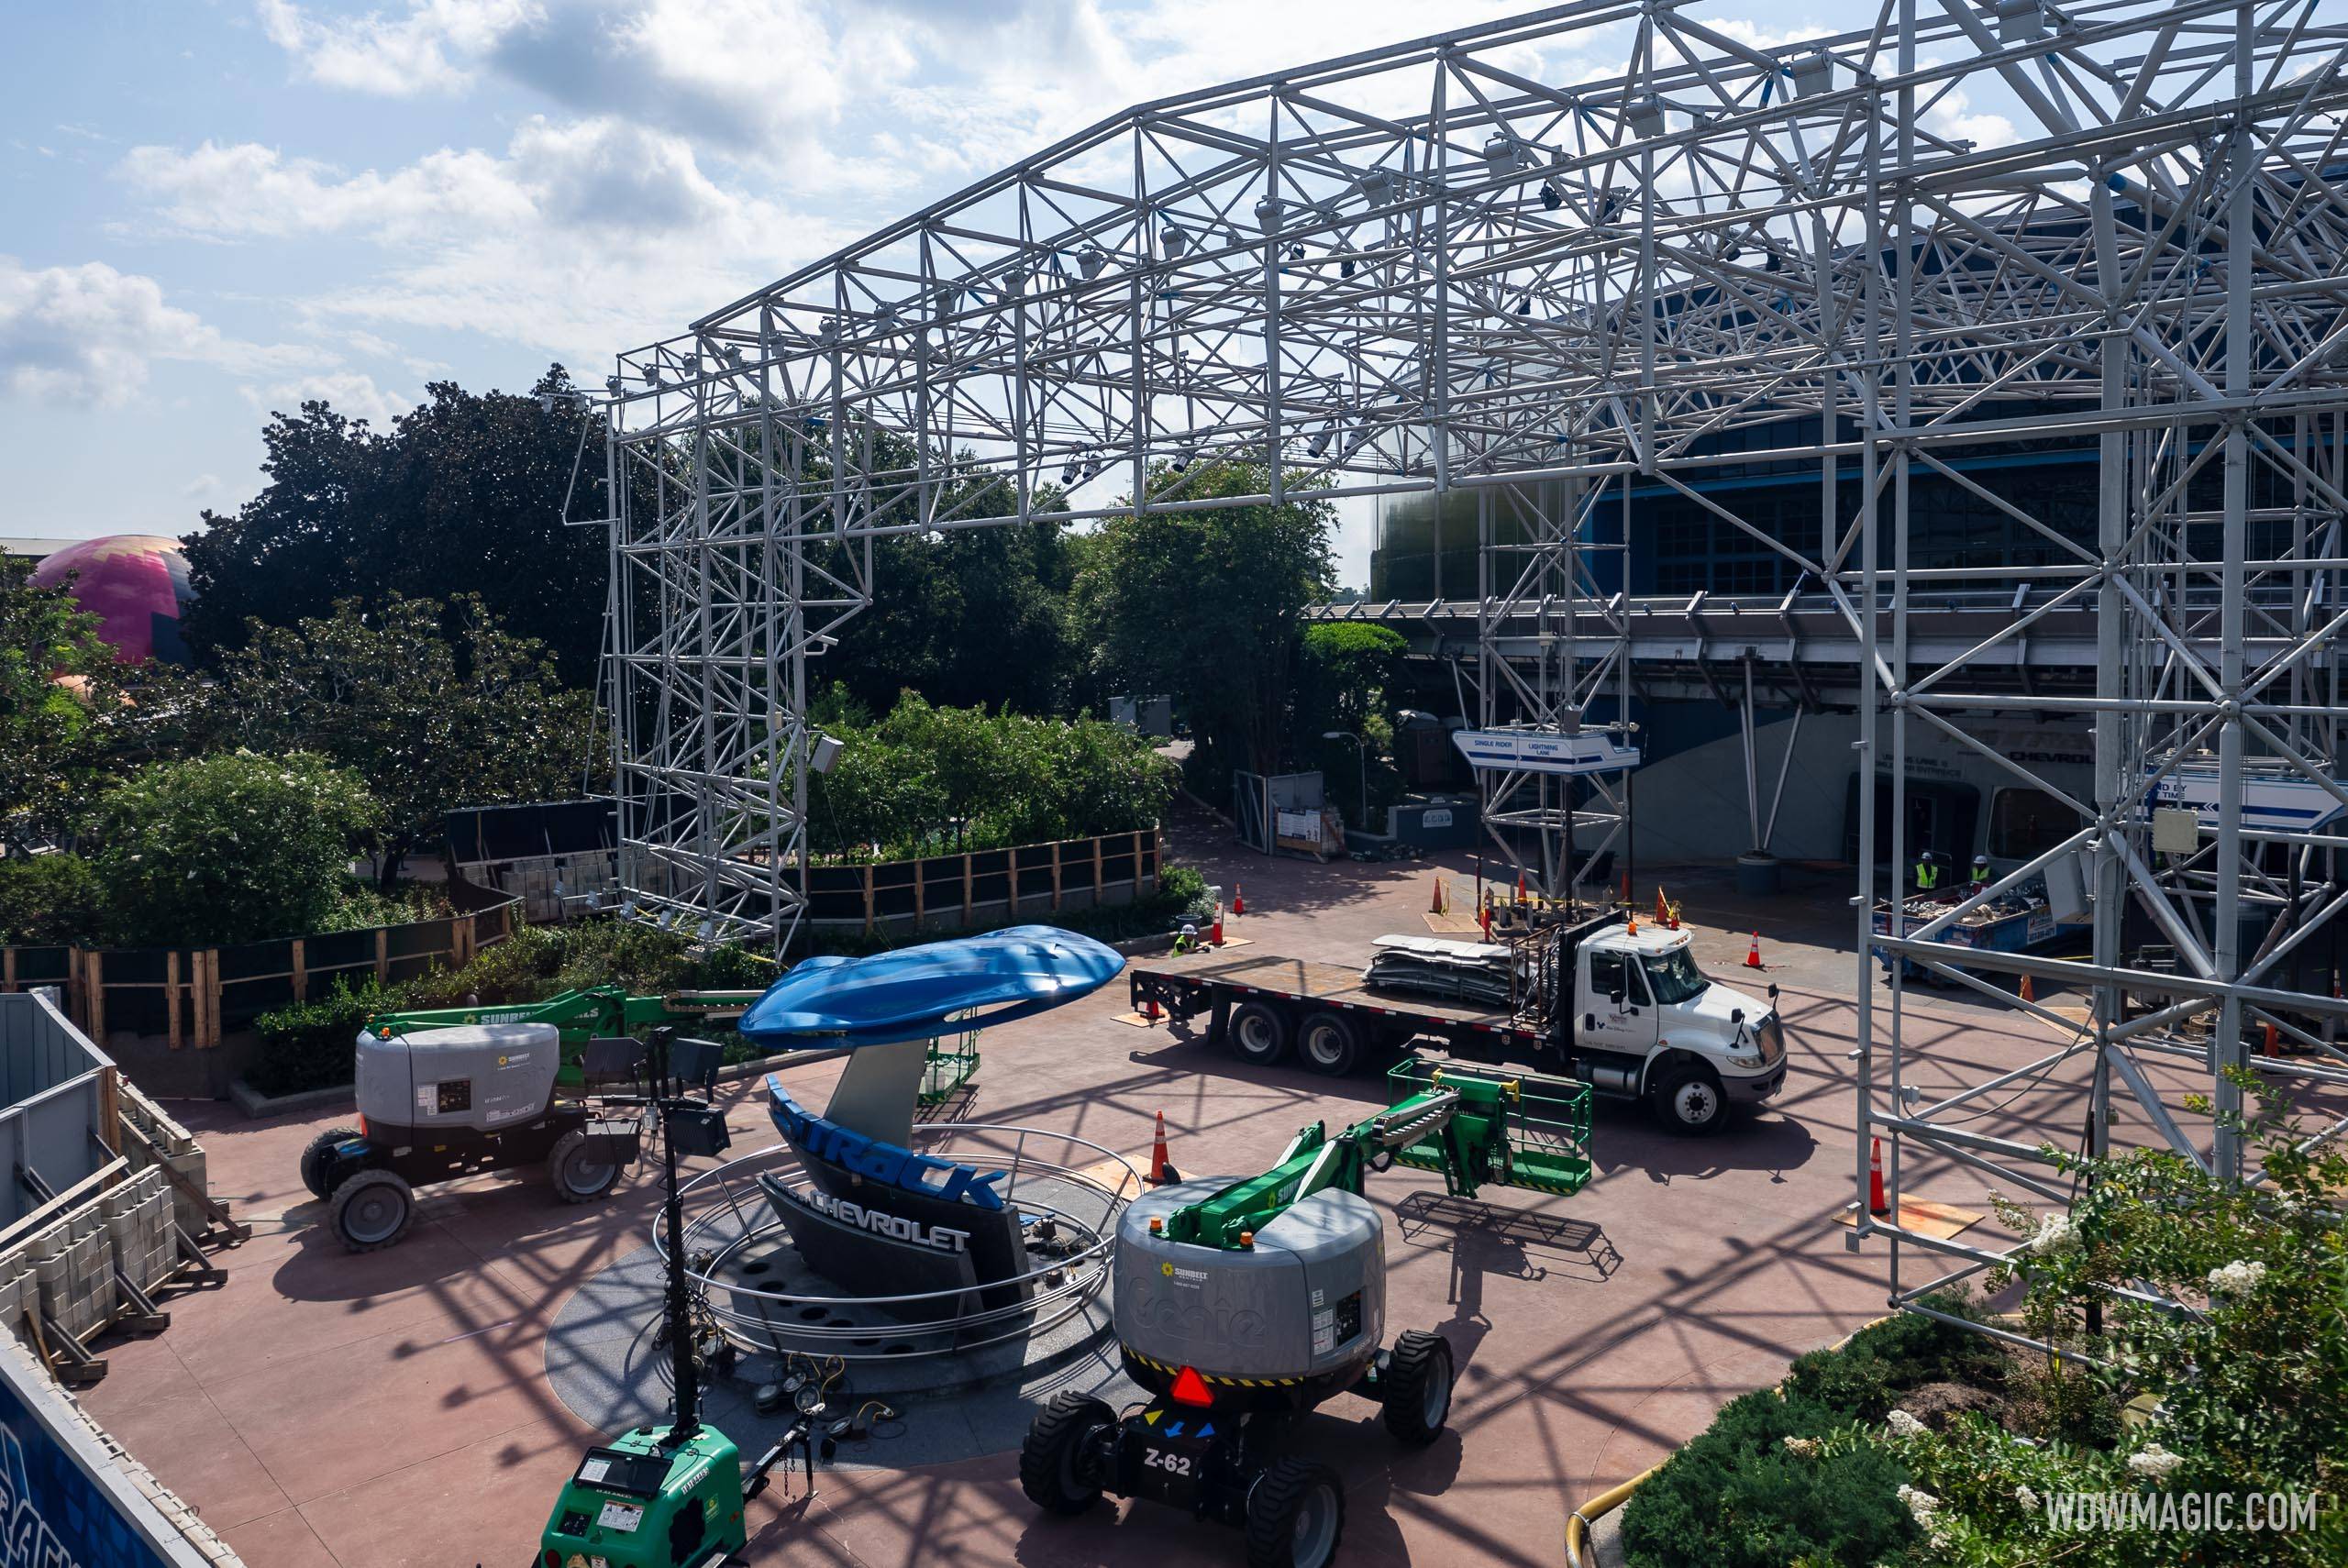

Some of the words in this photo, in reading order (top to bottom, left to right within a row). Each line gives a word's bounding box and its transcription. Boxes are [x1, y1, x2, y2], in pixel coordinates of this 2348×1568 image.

[2008, 751, 2096, 765] CHEVROL
[810, 1189, 971, 1253] CHEVROLET
[1174, 1267, 1209, 1280] SUNBELT
[1145, 1447, 1191, 1476] Z-62
